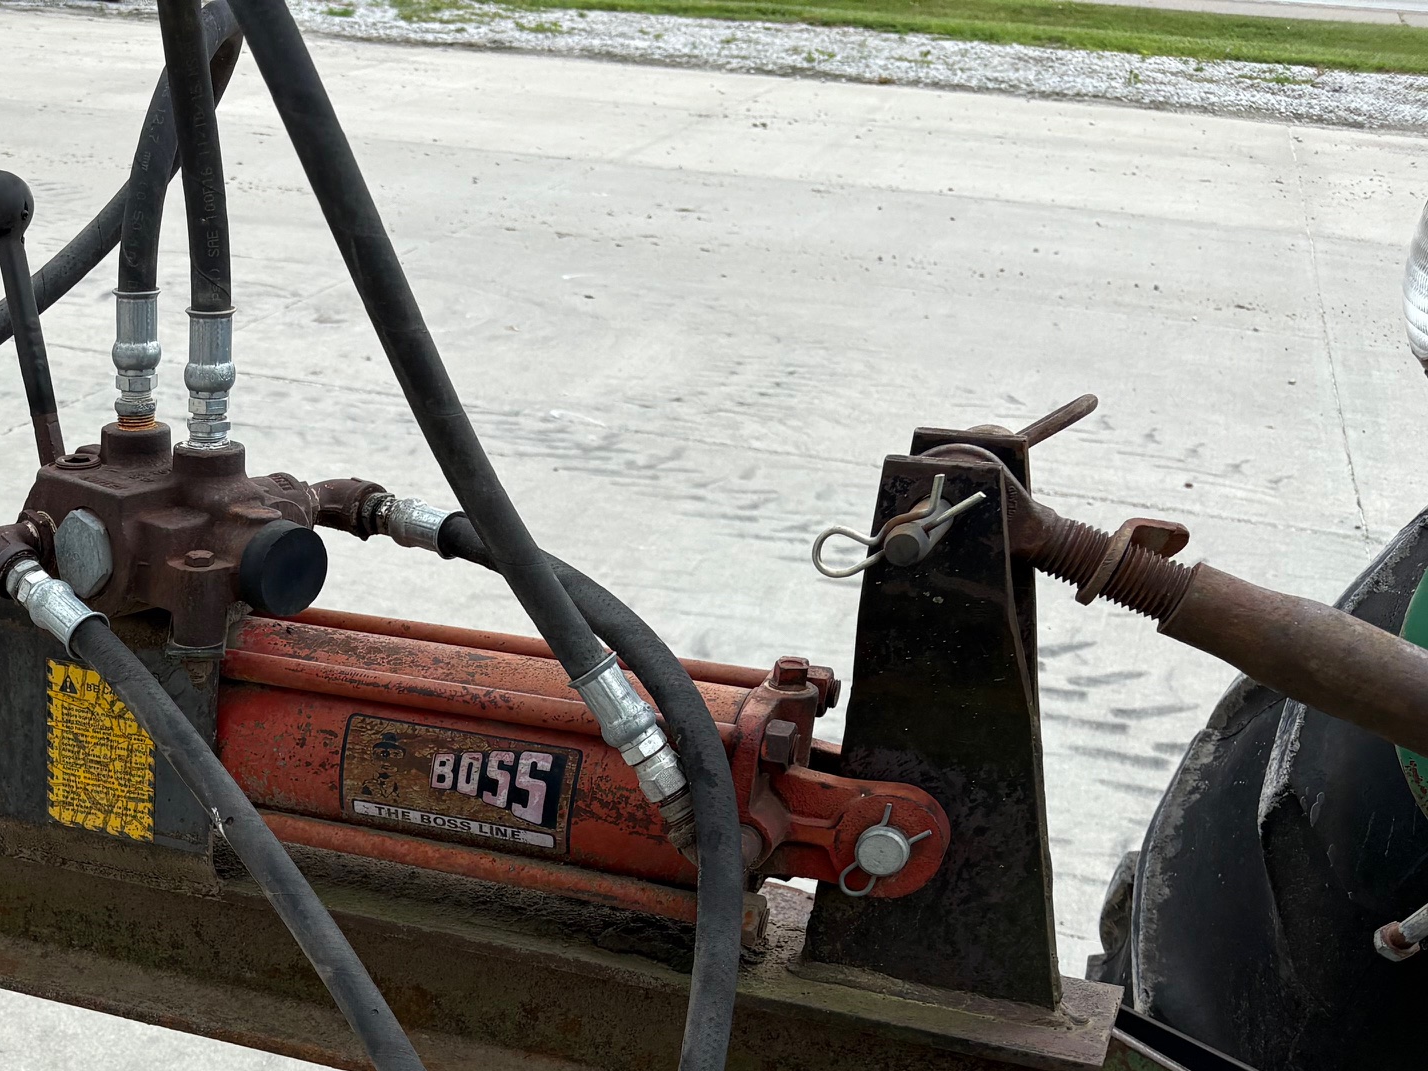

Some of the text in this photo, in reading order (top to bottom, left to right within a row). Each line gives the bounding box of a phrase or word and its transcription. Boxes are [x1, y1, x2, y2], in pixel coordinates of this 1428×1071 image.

[148, 108, 166, 144] 12.7
[206, 230, 221, 258] SAE
[85, 682, 100, 693] BE
[430, 750, 554, 826] BOSS
[374, 805, 523, 842] THE BOSS LINE
